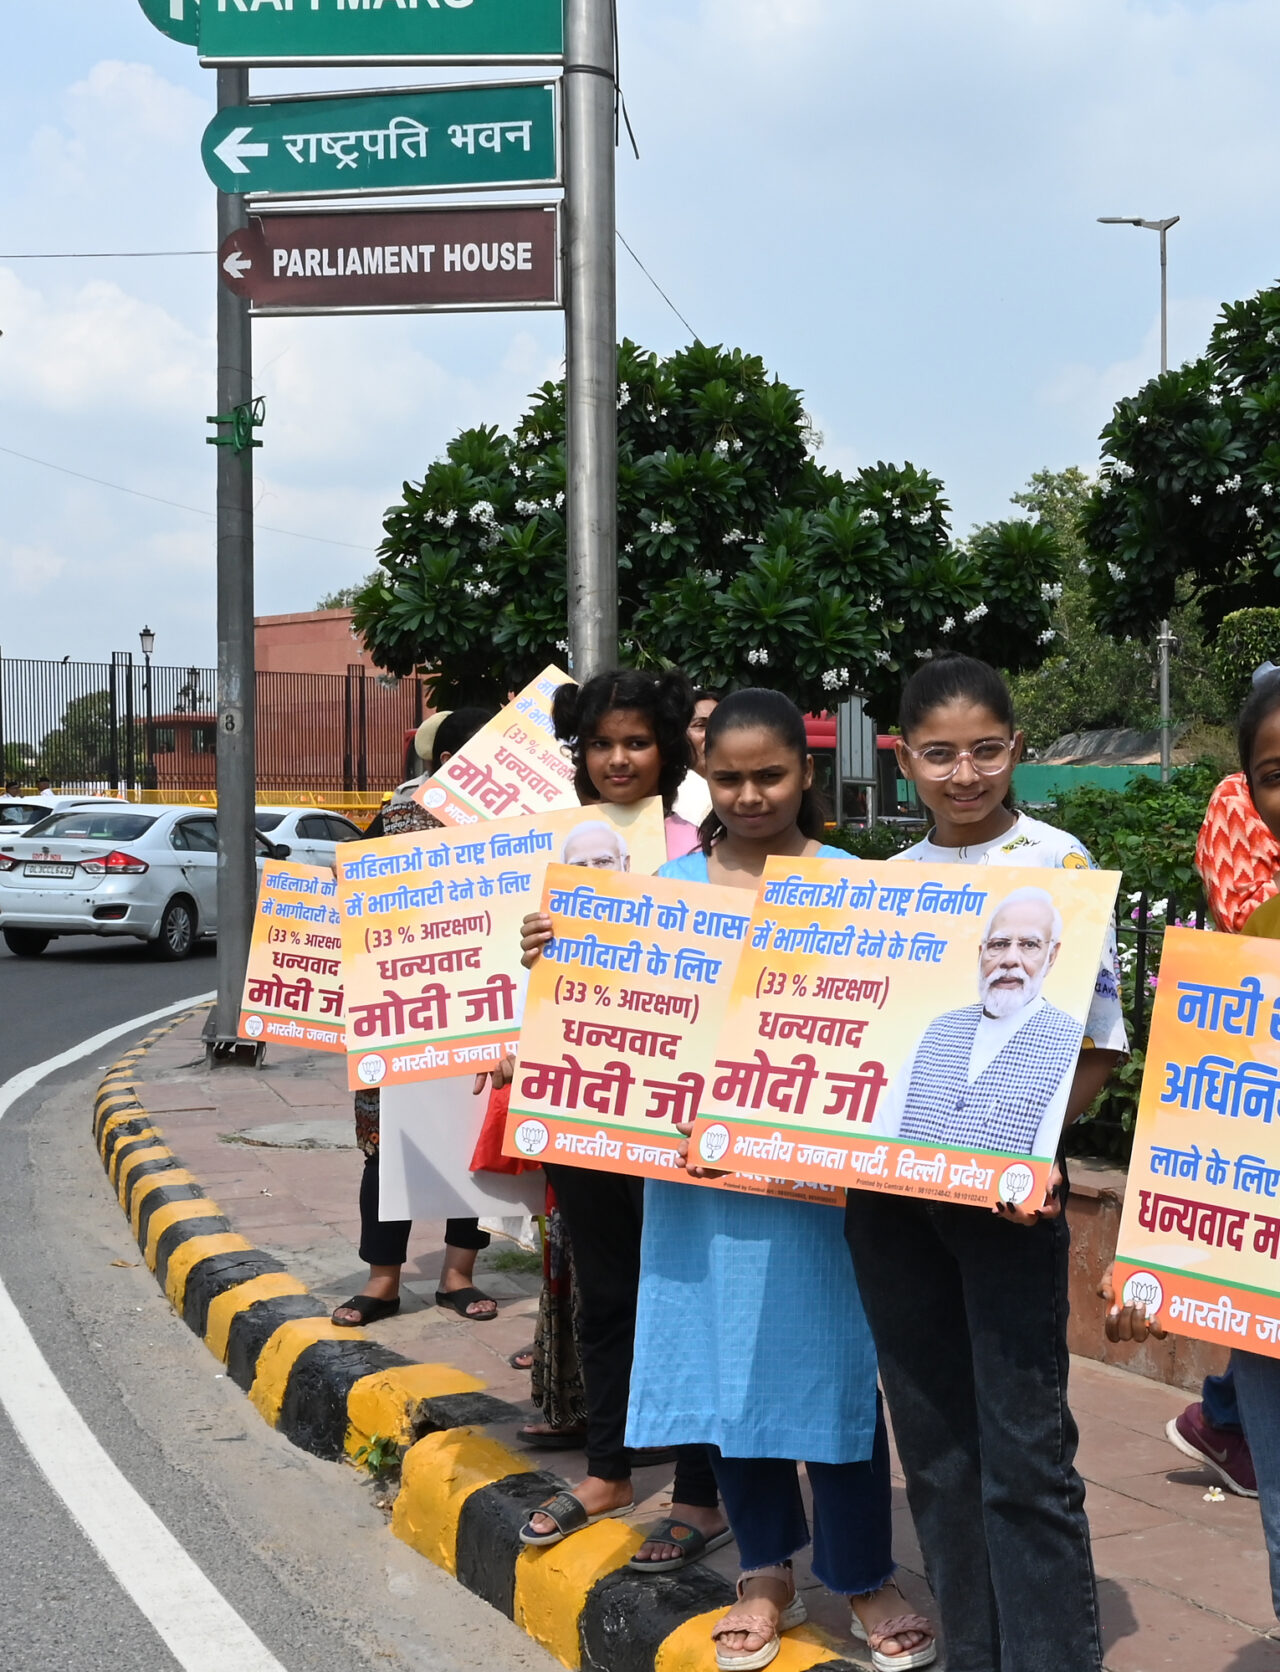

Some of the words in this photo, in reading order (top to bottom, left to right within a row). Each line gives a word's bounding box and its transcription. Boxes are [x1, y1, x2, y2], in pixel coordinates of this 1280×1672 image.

[283, 116, 428, 169] राष्ट्रपति
[447, 120, 533, 155] भवन
[273, 245, 435, 277] PARLIAMENT
[444, 242, 532, 272] HOUSE
[447, 755, 521, 816] मोदी
[494, 746, 562, 803] धन्यवाद
[343, 847, 423, 880] महिलाओं
[426, 843, 450, 868] को
[454, 842, 486, 864] राष्ट्र
[490, 829, 553, 859] निर्माण
[266, 872, 319, 894] महिलाओं
[321, 878, 337, 896] को
[345, 892, 365, 917] में
[368, 880, 444, 914] भागीदारी
[448, 878, 474, 902] देने
[478, 875, 494, 897] के
[497, 871, 531, 895] लिए
[763, 875, 848, 911] महिलाओं
[850, 879, 878, 911] को
[879, 886, 914, 916] राष्ट्र
[915, 881, 987, 916] निर्माण
[262, 898, 275, 915] में
[276, 902, 327, 923] भागीदारी
[365, 928, 392, 953] (33
[398, 926, 414, 944] %
[421, 910, 492, 940] आरक्षण)
[549, 886, 652, 927] महिलाओं
[657, 900, 689, 933] को
[693, 910, 750, 940] शास
[268, 925, 287, 944] (33
[290, 931, 300, 945] %
[751, 921, 774, 950] में
[773, 924, 856, 957] भागीदारी
[856, 931, 887, 957] देने
[888, 936, 908, 958] के
[908, 933, 948, 963] लिए
[272, 952, 341, 976] धन्यवाद
[377, 946, 482, 980] धन्यवाद
[544, 935, 643, 973] भागीदारी
[649, 945, 675, 976] के
[675, 948, 722, 984] लिए
[248, 973, 315, 1012] मोदी
[318, 984, 344, 1017] ज
[349, 983, 451, 1037] मोदी
[457, 974, 517, 1022] जी
[554, 975, 587, 1004] (33
[594, 986, 611, 1007] %
[617, 989, 700, 1024] आरक्षण)
[756, 966, 788, 998] (33
[792, 975, 807, 996] %
[812, 977, 890, 1009] आरक्षण)
[1176, 976, 1265, 1030] नारी
[562, 1018, 682, 1060] धन्यवाद
[758, 1012, 869, 1049] धन्यवाद
[392, 1046, 449, 1072] भारतीय
[452, 1043, 501, 1063] जनता
[520, 1054, 635, 1117] मोदी
[643, 1072, 705, 1124] जी
[712, 1050, 818, 1115] मोदी
[823, 1061, 888, 1123] जी
[554, 1130, 623, 1160] भारतीय
[733, 1133, 794, 1163] भारतीय
[796, 1145, 848, 1170] जनता
[898, 1153, 948, 1185] दिल्ली
[950, 1160, 995, 1192] प्रदेश
[1150, 1144, 1202, 1183] लाने
[1205, 1149, 1230, 1186] के
[1138, 1189, 1249, 1251] धन्यवाद
[1168, 1292, 1251, 1337] भारतीय
